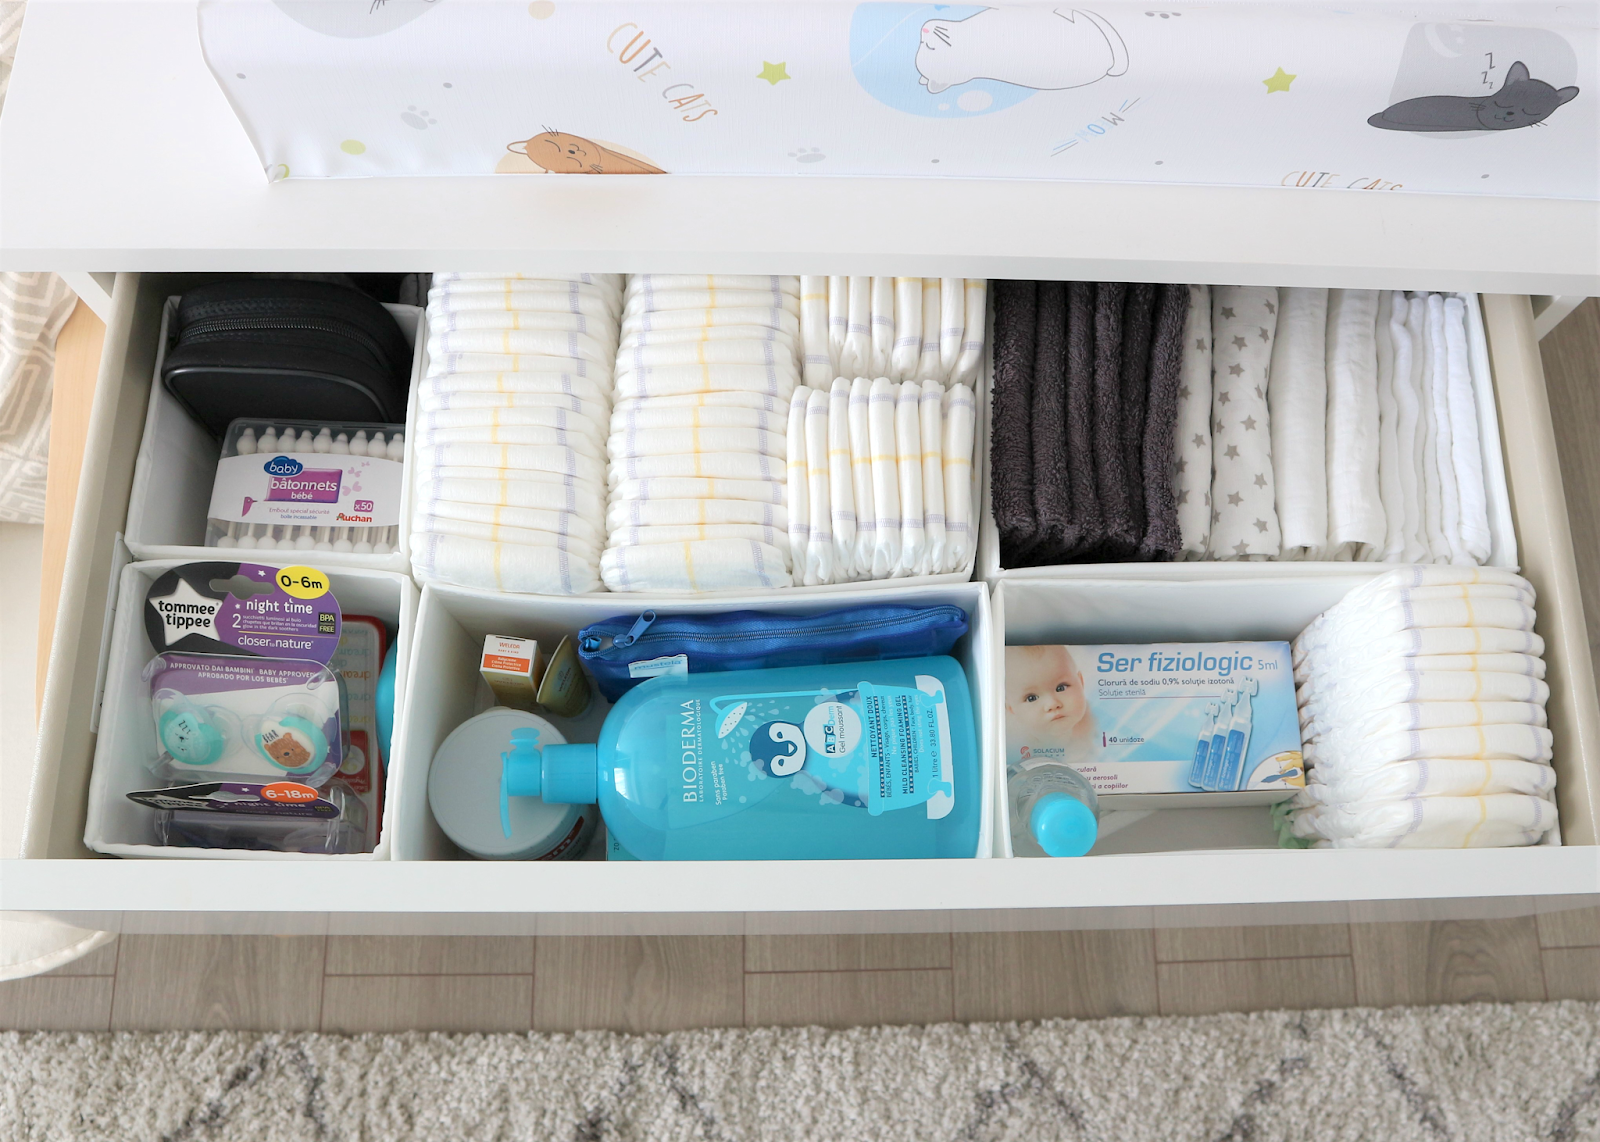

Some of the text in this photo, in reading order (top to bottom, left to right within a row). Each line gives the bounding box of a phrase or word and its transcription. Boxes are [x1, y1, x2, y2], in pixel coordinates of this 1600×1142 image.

[606, 21, 718, 122] CUTE CATS
[269, 461, 298, 474] baby
[270, 478, 338, 492] bâtonnets
[291, 492, 313, 500] bébé
[354, 502, 374, 512] x50
[336, 512, 373, 523] Auchan
[280, 575, 323, 590] 0-6m
[158, 600, 216, 615] tommee
[246, 598, 313, 615] night time
[165, 613, 211, 630] tippee
[232, 613, 242, 628] 2
[319, 614, 335, 622] BPA
[319, 625, 334, 633] FREE
[237, 635, 271, 647] closer
[275, 639, 312, 650] nature
[169, 662, 210, 671] APPROVATO
[225, 666, 253, 674] BAMBINI
[633, 659, 682, 671] mustela
[1096, 651, 1279, 677] Ser fiziologic 5ml
[198, 672, 234, 680] APROBADO
[1098, 678, 1128, 687] Clorură
[1129, 678, 1138, 686] de
[1140, 677, 1160, 686] sodiu
[1207, 676, 1235, 685] izotonă
[835, 705, 846, 754] Gel moussant
[866, 695, 878, 758] NETTOYANT DOUX
[889, 717, 897, 728] pas
[896, 708, 905, 737] FOAMING
[261, 729, 280, 743] BEAR
[890, 728, 898, 745] pique
[929, 729, 937, 747] 33.80
[1118, 735, 1145, 743] unidoze
[681, 699, 698, 803] BIODERMA
[891, 745, 897, 755] Ne
[899, 738, 907, 776] CLEANSING
[710, 760, 722, 806] Sans paraben
[720, 776, 728, 801] Paraben
[901, 777, 909, 795] MILD
[1103, 783, 1129, 791] copiilor
[265, 789, 315, 800] 6-18m
